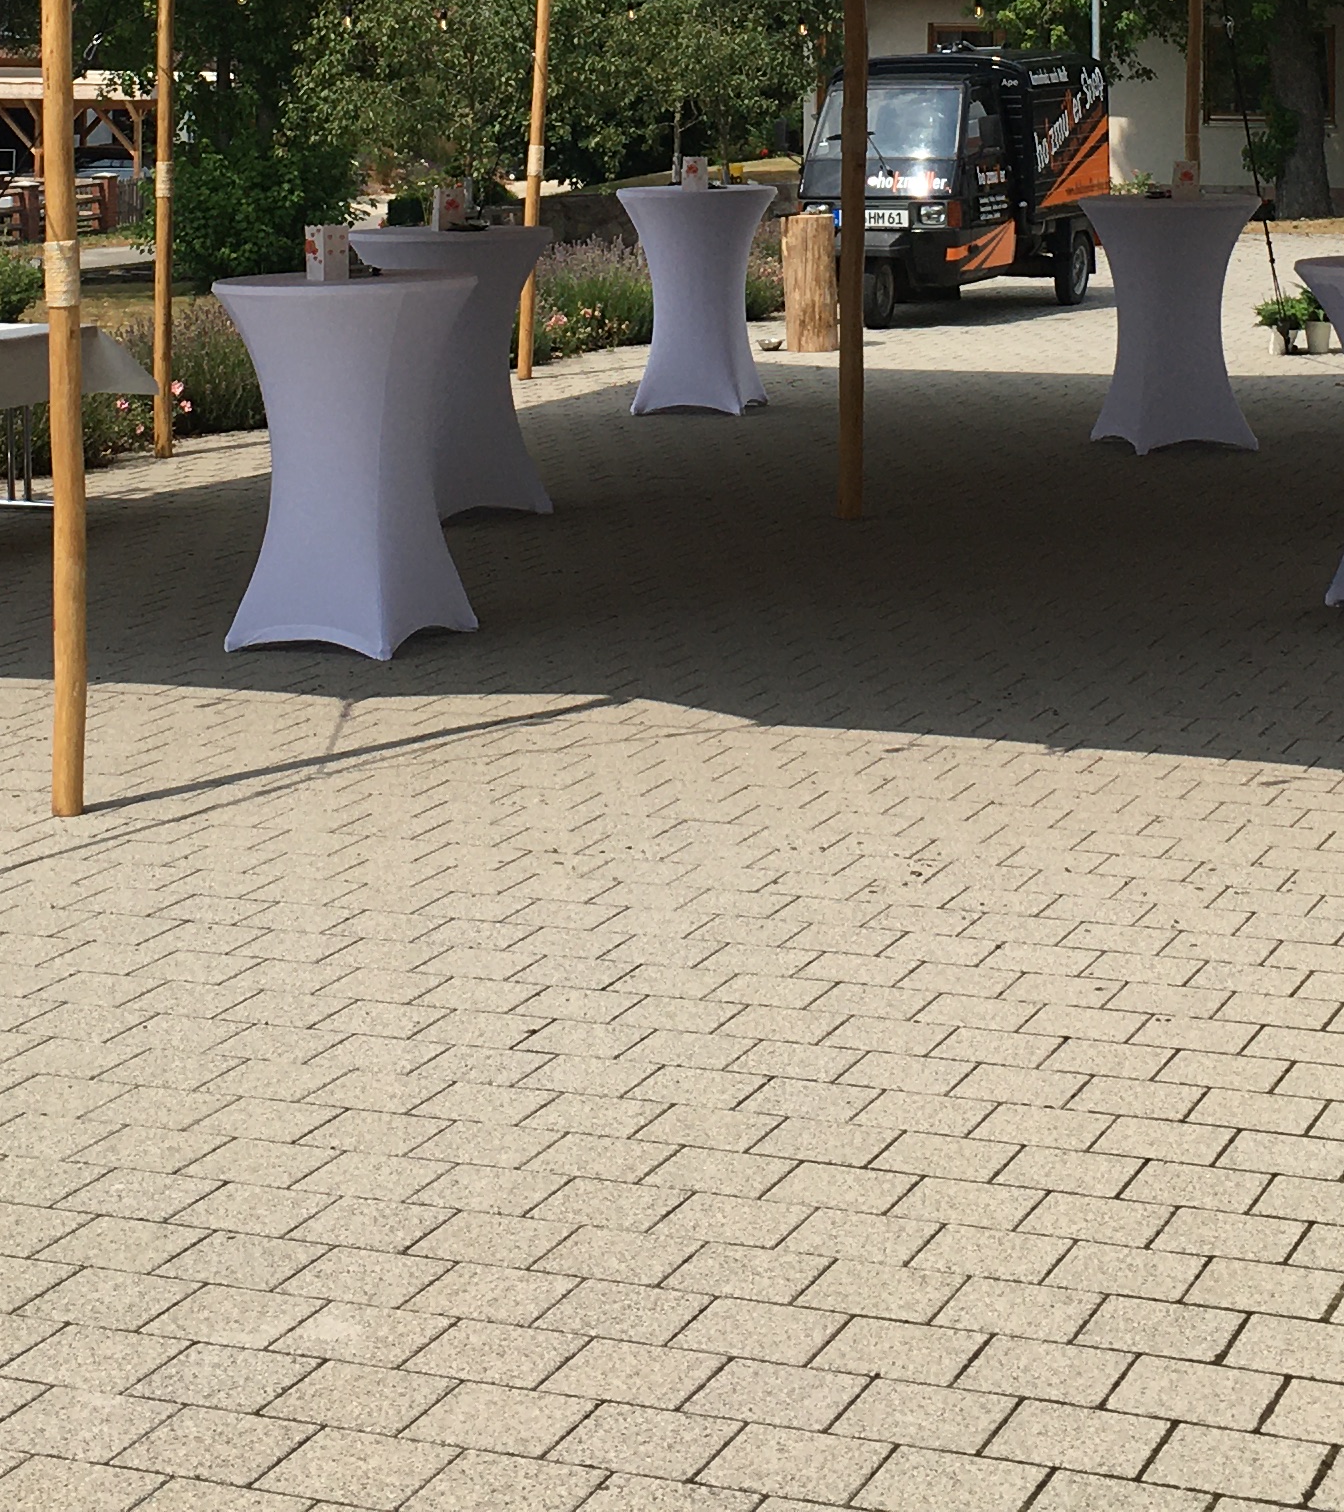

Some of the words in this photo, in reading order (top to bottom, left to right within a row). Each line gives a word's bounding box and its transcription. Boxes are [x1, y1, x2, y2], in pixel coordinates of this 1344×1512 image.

[1001, 78, 1018, 87] Ape
[868, 212, 885, 225] HM
[887, 212, 903, 225] 61
